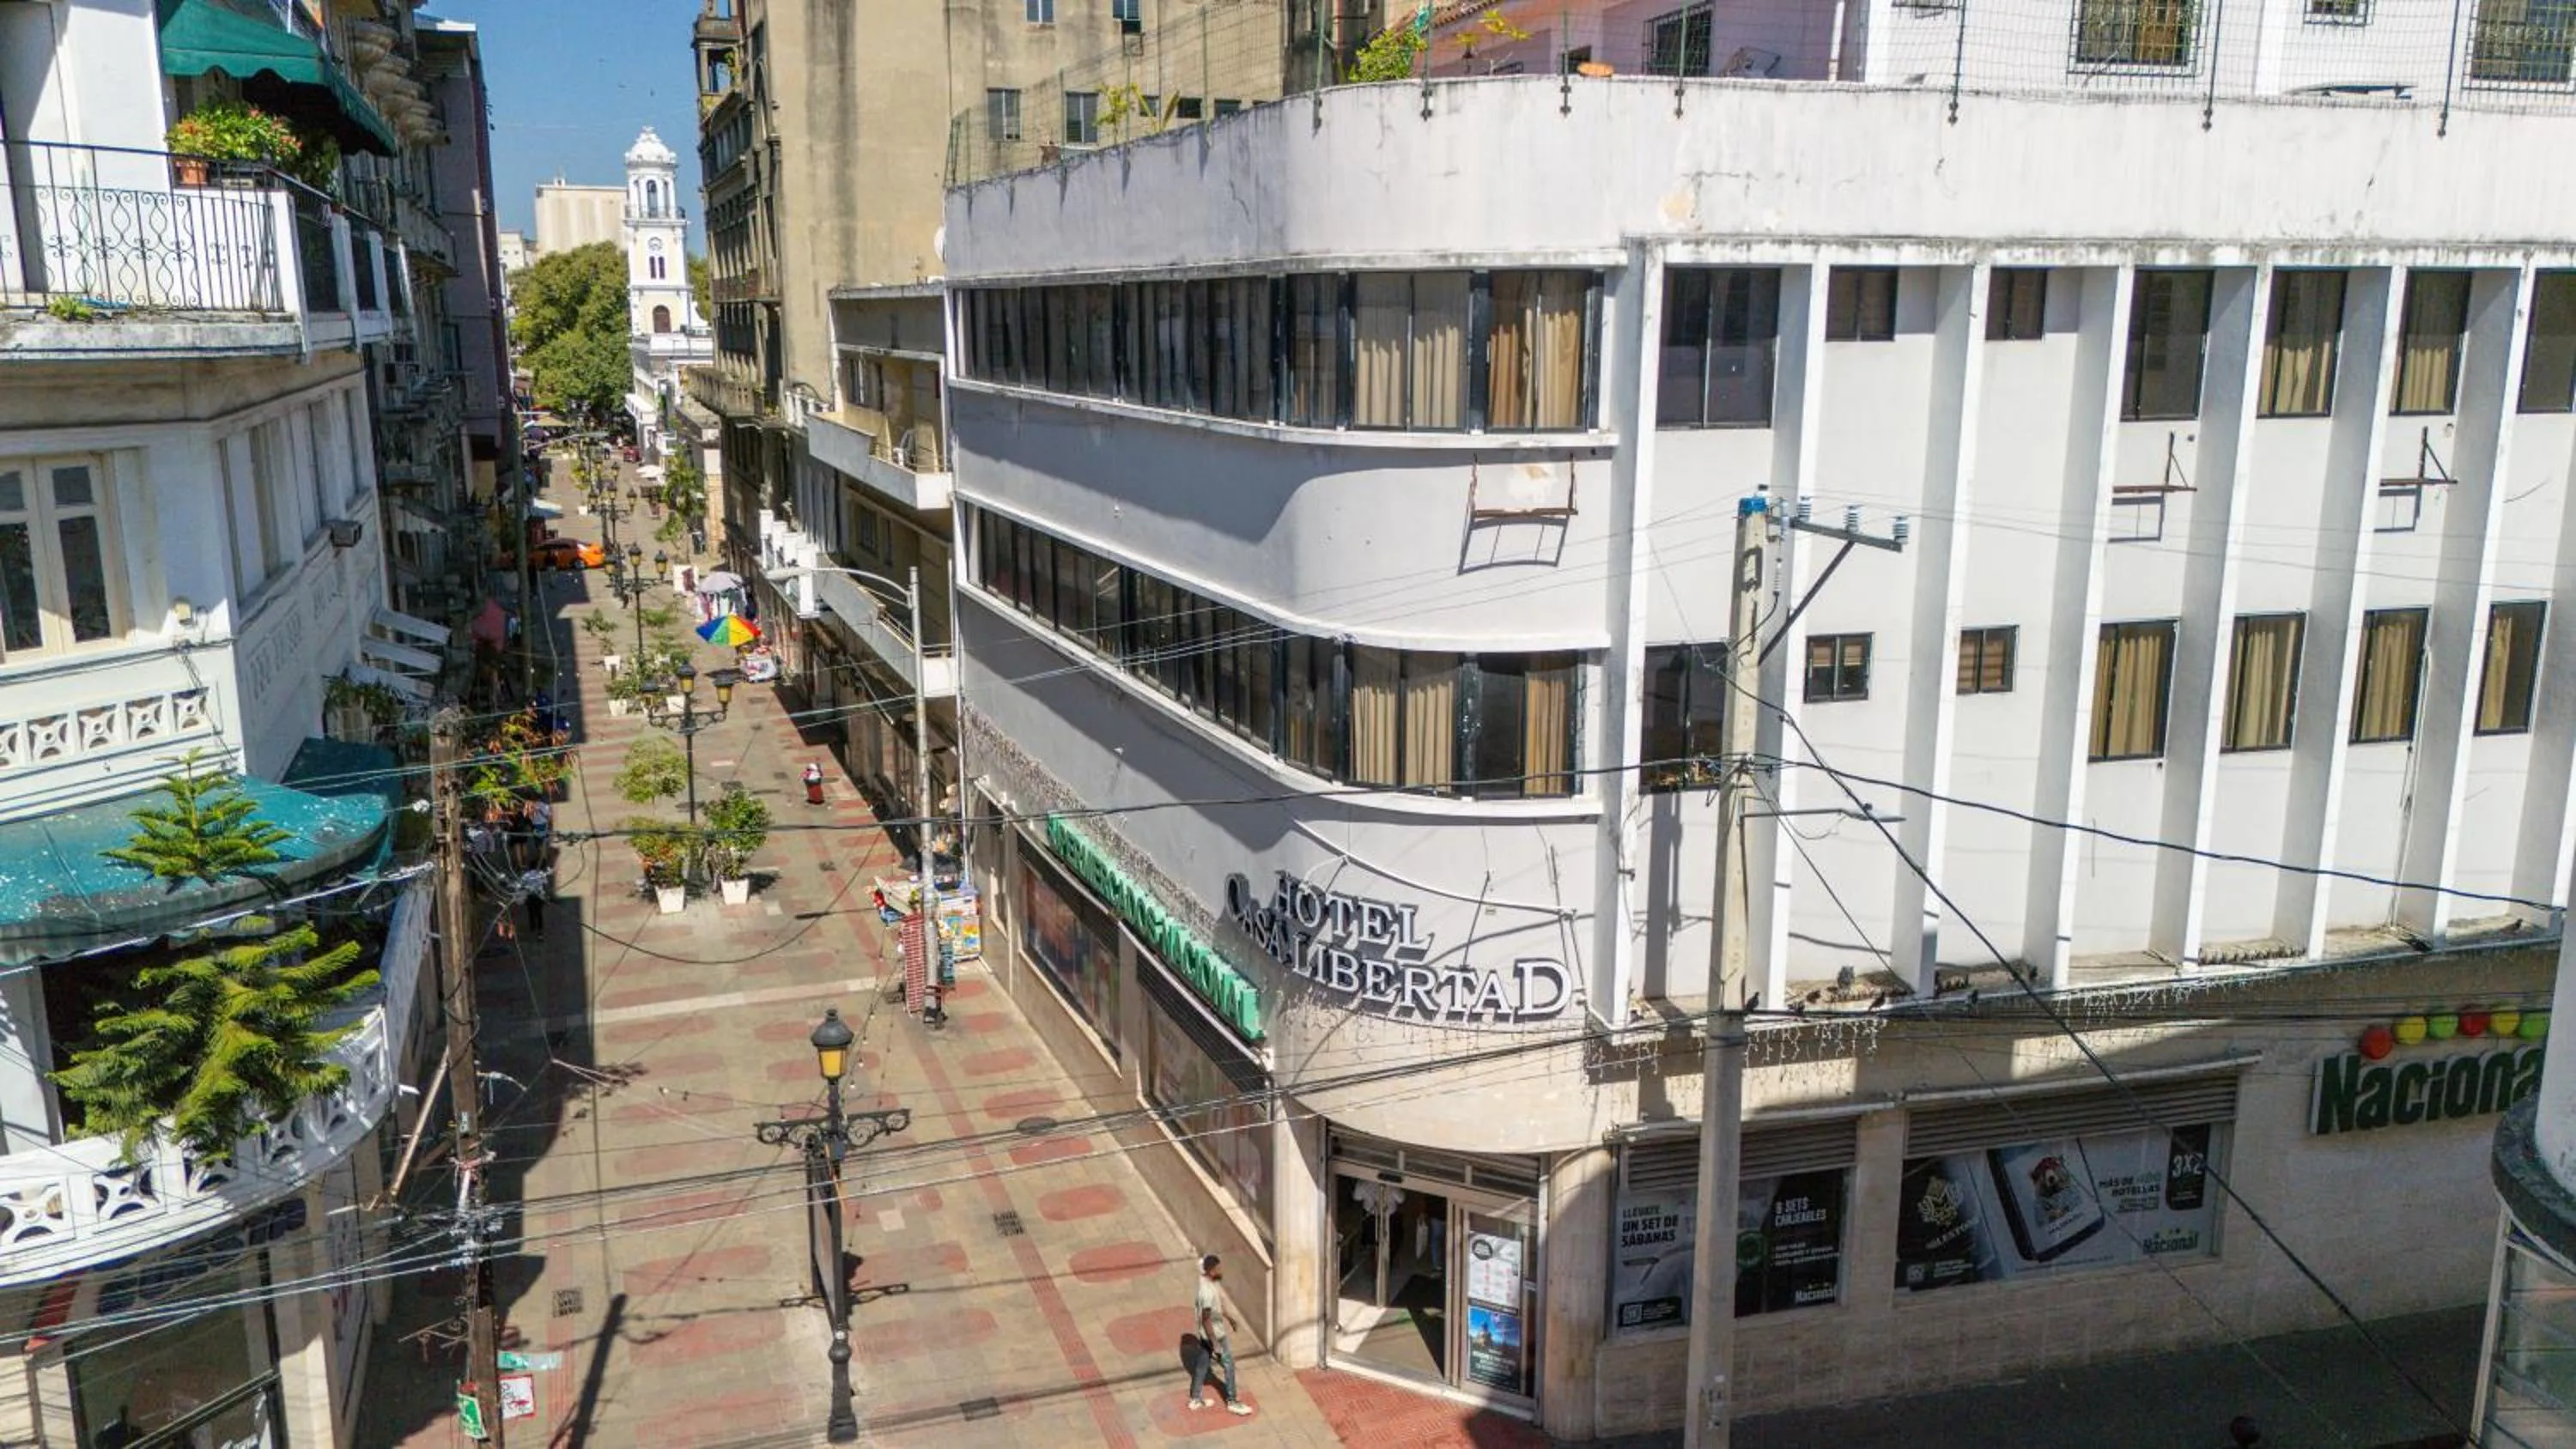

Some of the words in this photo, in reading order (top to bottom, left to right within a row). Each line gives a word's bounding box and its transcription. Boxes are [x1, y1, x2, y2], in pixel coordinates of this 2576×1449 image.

[1224, 872, 1286, 963] CASA
[1291, 932, 1573, 1019] LIBERTAD
[1275, 870, 1435, 957] HOTEL
[1160, 916, 1267, 1040] NACIONAL
[2311, 1047, 2545, 1136] Naciona
[1641, 1216, 1662, 1230] SET
[2142, 1231, 2200, 1254] Nacional
